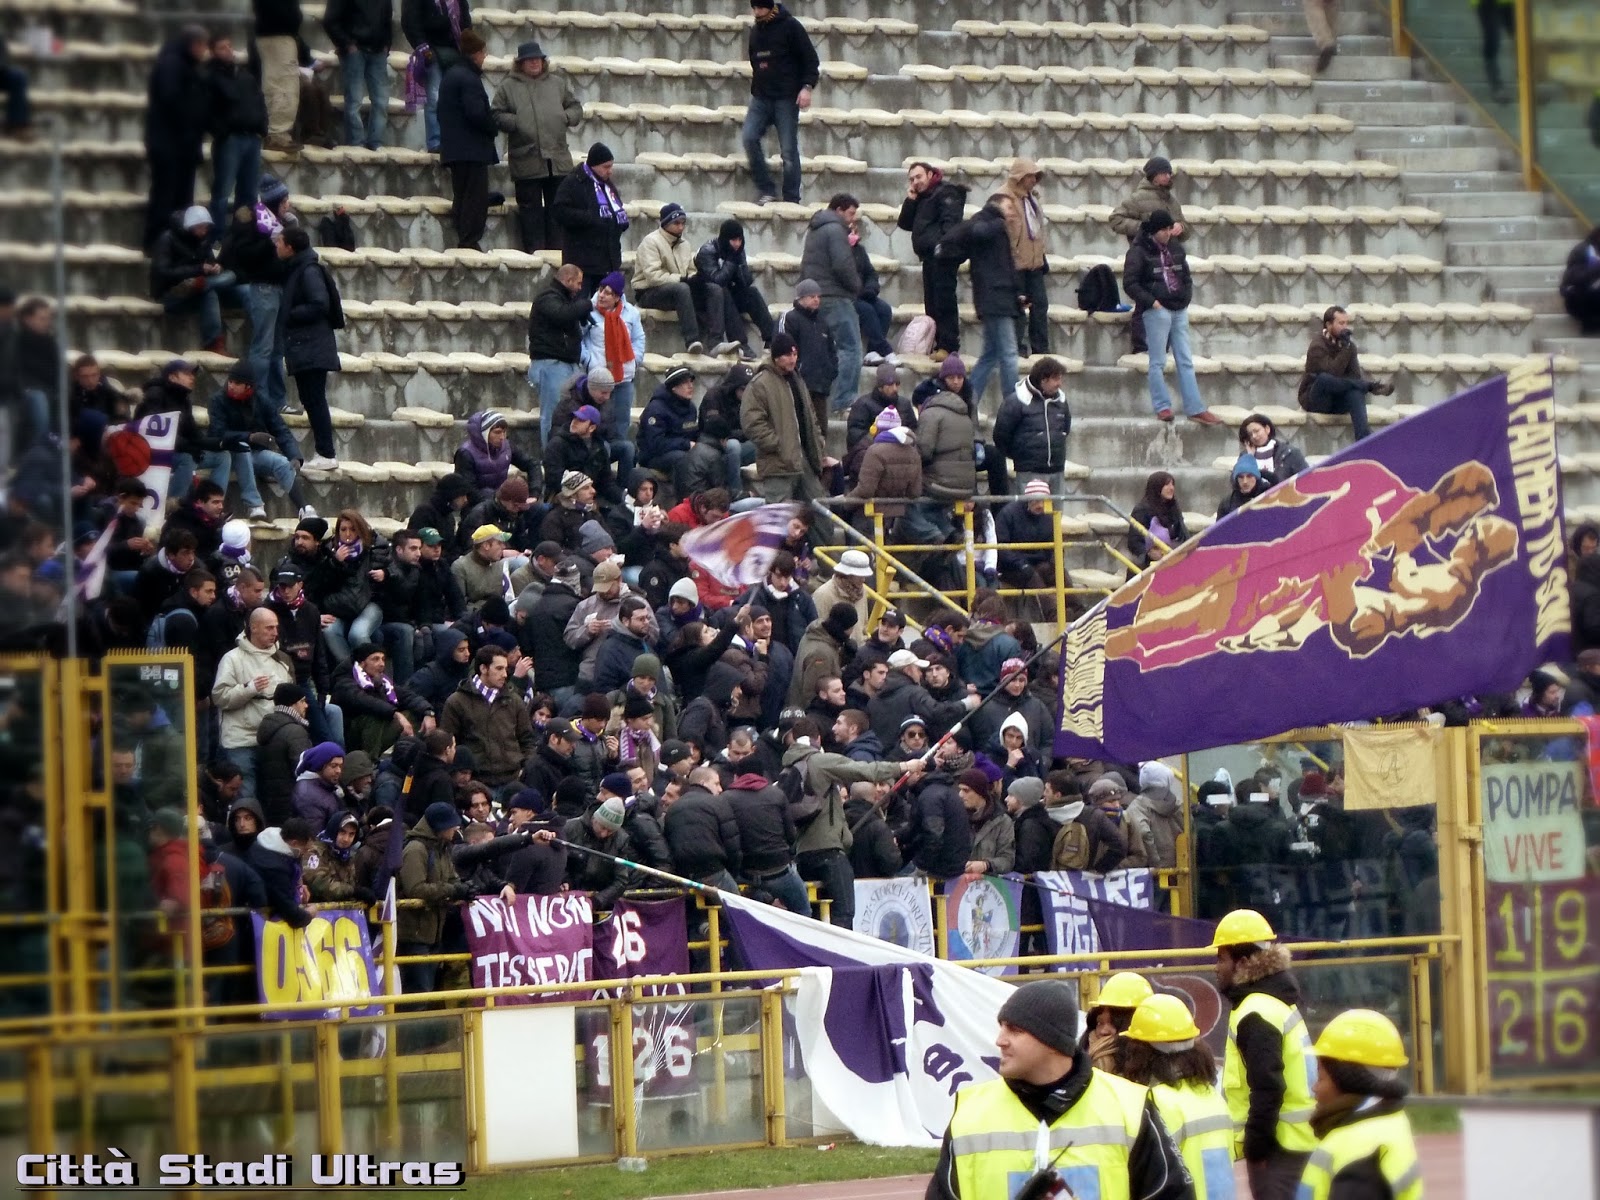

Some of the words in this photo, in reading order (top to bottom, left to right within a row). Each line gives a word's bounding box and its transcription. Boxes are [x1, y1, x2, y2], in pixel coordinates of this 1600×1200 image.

[1507, 396, 1558, 531] FATHER
[1526, 516, 1564, 578] TO
[1535, 567, 1572, 648] SON
[1486, 770, 1579, 822] POMPA
[1504, 832, 1563, 873] VIVE
[469, 898, 521, 938] NOI
[528, 895, 593, 938] NON
